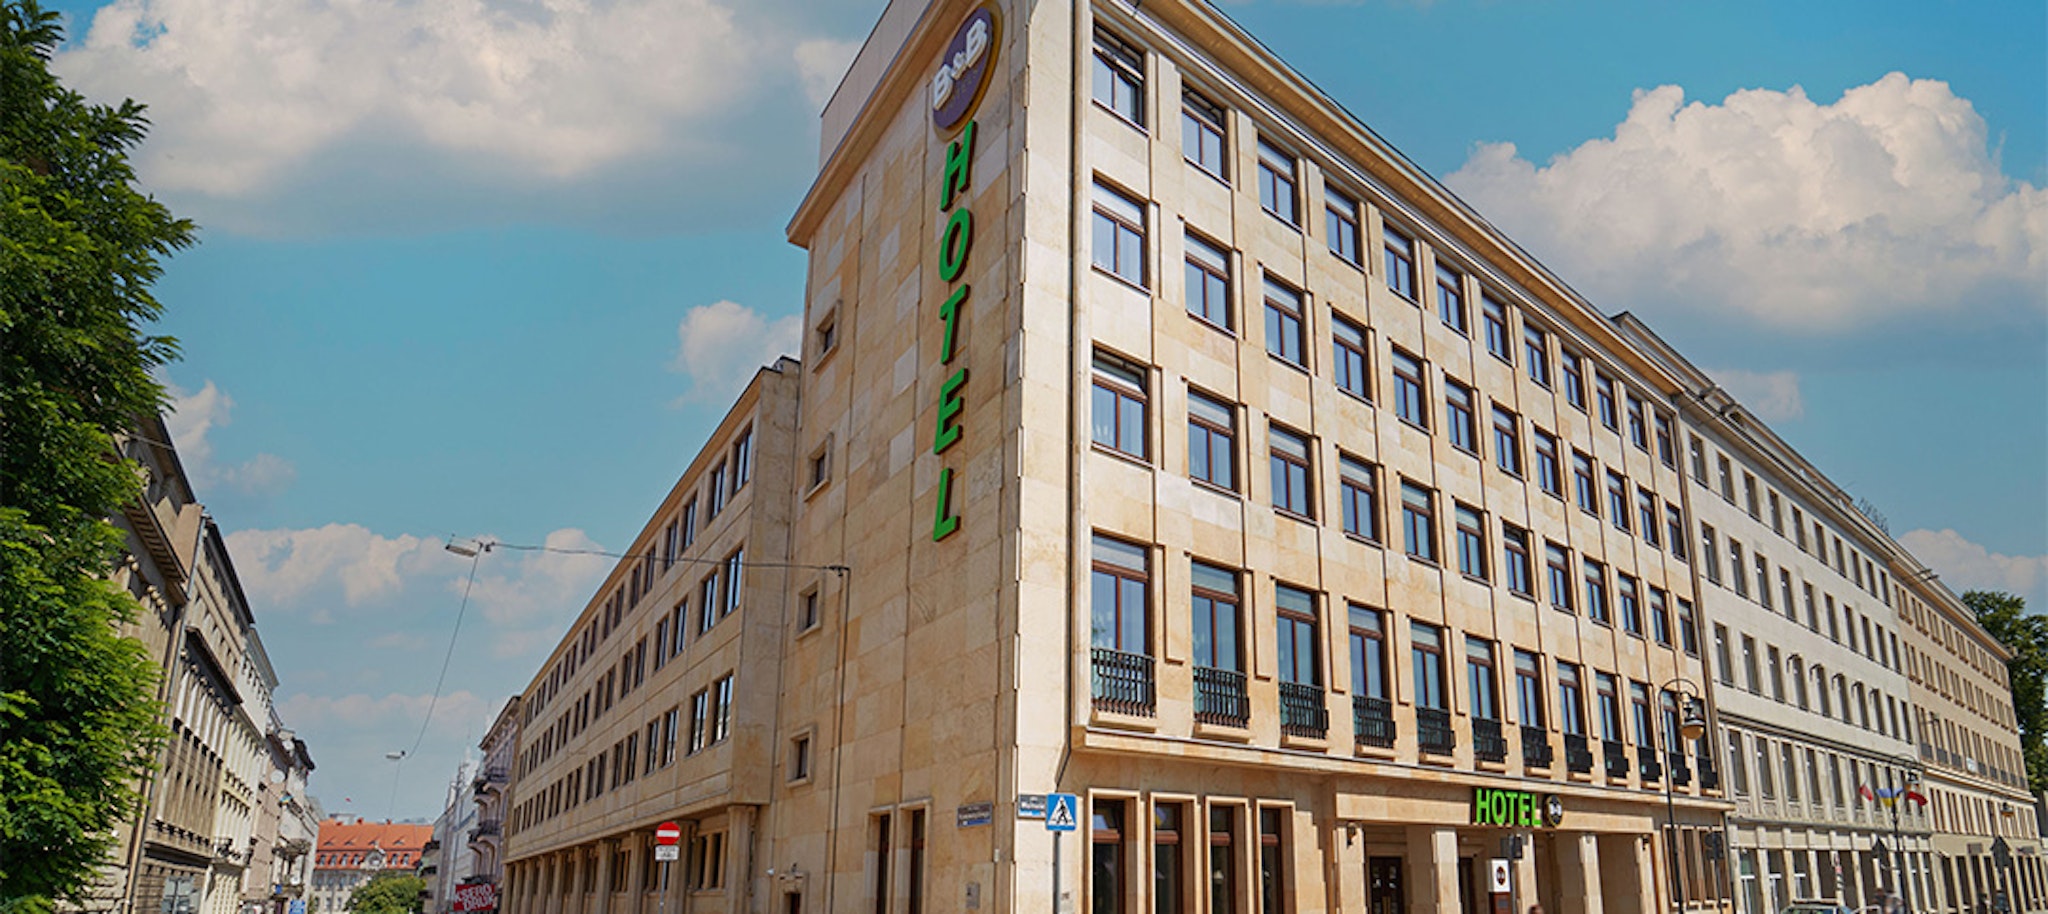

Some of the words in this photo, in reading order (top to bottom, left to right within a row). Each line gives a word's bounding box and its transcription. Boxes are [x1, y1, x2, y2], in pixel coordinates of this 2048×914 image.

[933, 18, 987, 111] B&B
[932, 119, 977, 543] HOTEL
[1476, 788, 1541, 826] HOTEL
